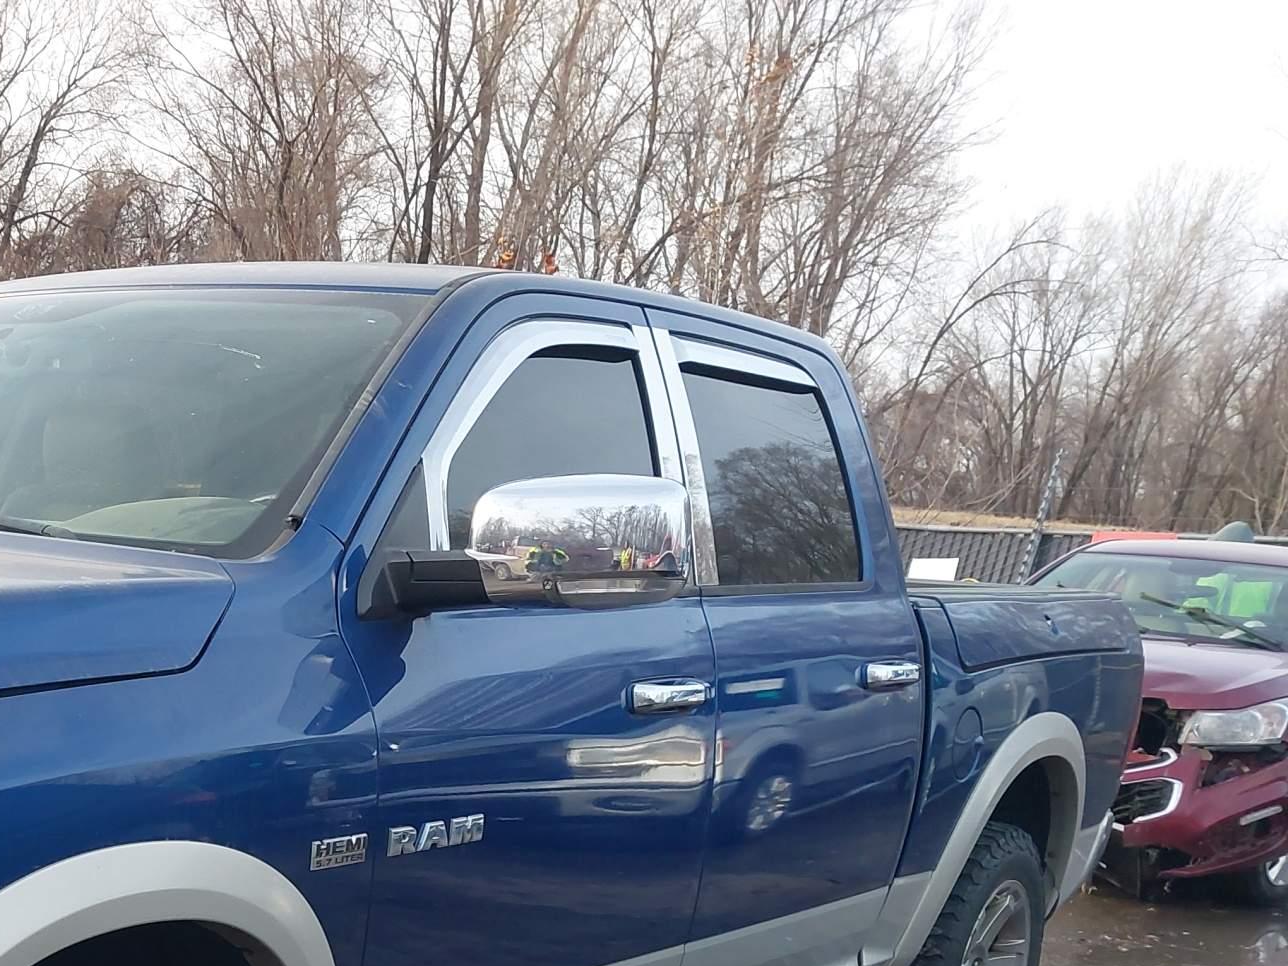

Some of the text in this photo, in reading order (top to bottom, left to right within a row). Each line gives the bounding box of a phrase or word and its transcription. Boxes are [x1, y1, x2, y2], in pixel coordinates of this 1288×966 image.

[314, 834, 367, 858] HEMI
[387, 814, 484, 856] RAM
[335, 853, 364, 866] LITER
